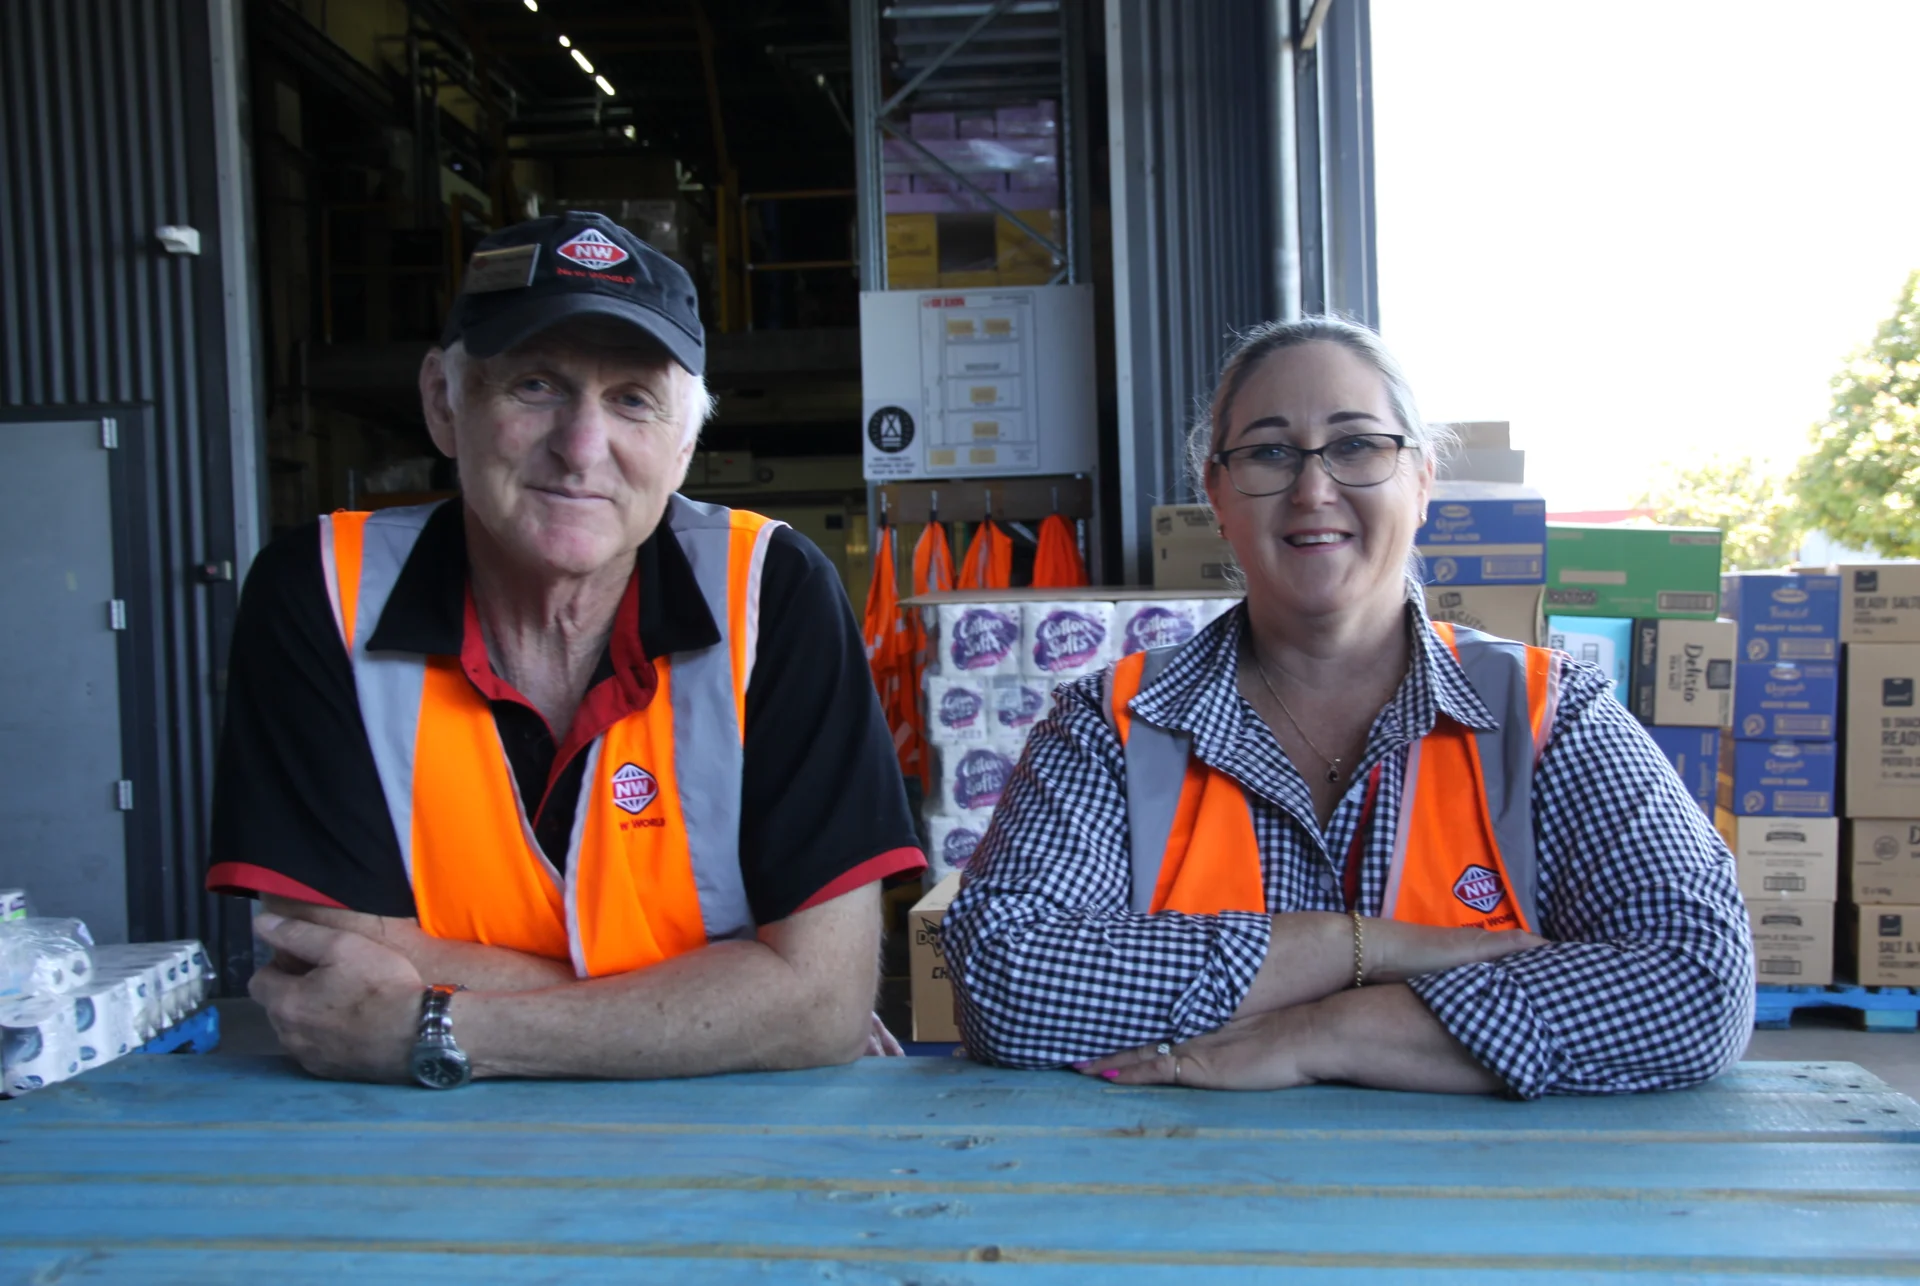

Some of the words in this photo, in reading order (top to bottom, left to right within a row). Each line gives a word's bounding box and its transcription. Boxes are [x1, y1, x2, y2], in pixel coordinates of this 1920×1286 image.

[575, 244, 613, 259] NW
[1854, 596, 1888, 609] READY
[960, 616, 1003, 638] Cotton
[1043, 617, 1092, 638] Cotton
[1133, 613, 1179, 636] Cotton
[1683, 643, 1704, 702] Delisio
[962, 756, 1003, 777] Cotton
[615, 779, 649, 798] NW
[631, 817, 666, 828] WORLD
[1463, 878, 1497, 899] NW
